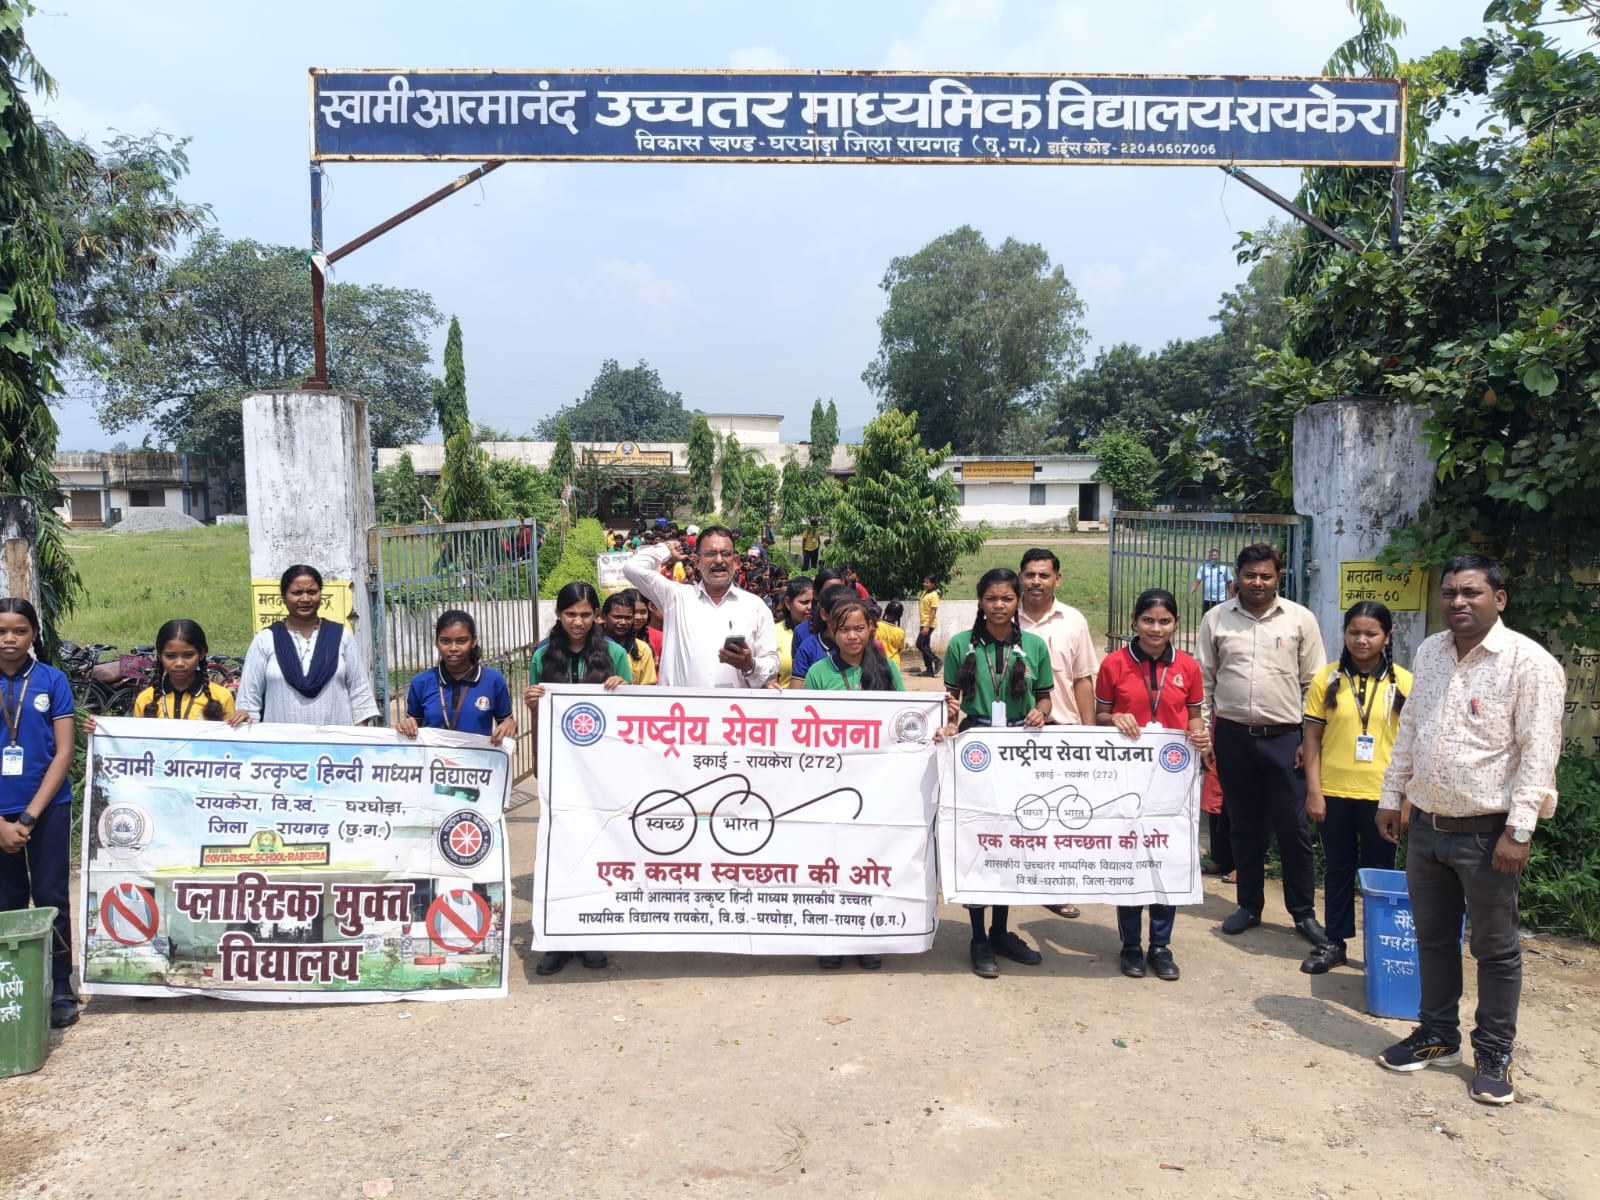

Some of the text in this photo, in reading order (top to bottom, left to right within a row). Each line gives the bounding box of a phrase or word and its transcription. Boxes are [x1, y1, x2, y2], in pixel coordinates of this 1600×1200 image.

[319, 75, 409, 129] स्वामी
[412, 80, 586, 134] आत्मानंद
[595, 91, 793, 129] उच्चतर
[800, 78, 1043, 131] माध्यमिक
[635, 129, 703, 153] विकास
[843, 129, 893, 155] जिला
[897, 135, 963, 157] रायगढ़
[617, 702, 710, 758] राष्ट्रीय
[722, 703, 779, 747] सेवा
[791, 704, 883, 749] योजना
[693, 751, 728, 769] इकाई
[746, 752, 792, 769] रायकेरा
[799, 753, 843, 772] (272)
[998, 739, 1053, 767] राष्ट्रीय
[1056, 739, 1092, 762] सेवा
[1095, 739, 1154, 762] योजना
[102, 750, 493, 789] स्वामी आत्मानंद उत्कृष्ट हिन्दी माध्यम विद्यालय
[208, 815, 248, 835] जिला
[645, 817, 759, 832] स्वच्छ भारत
[978, 828, 1170, 851] एक कदम स्वच्छता की ओर
[596, 856, 893, 888] एक कदम स्वच्छता की ओर
[174, 872, 413, 936] प्लास्टिक मुक्त
[615, 888, 873, 909] स्वामी आत्मानंद उत्कृष्ट हिन्दी माध्यम शासकीय उच्चतर
[578, 907, 625, 925] माध्यमिक
[628, 907, 670, 924] विद्यालय
[219, 932, 364, 983] विद्यालय
